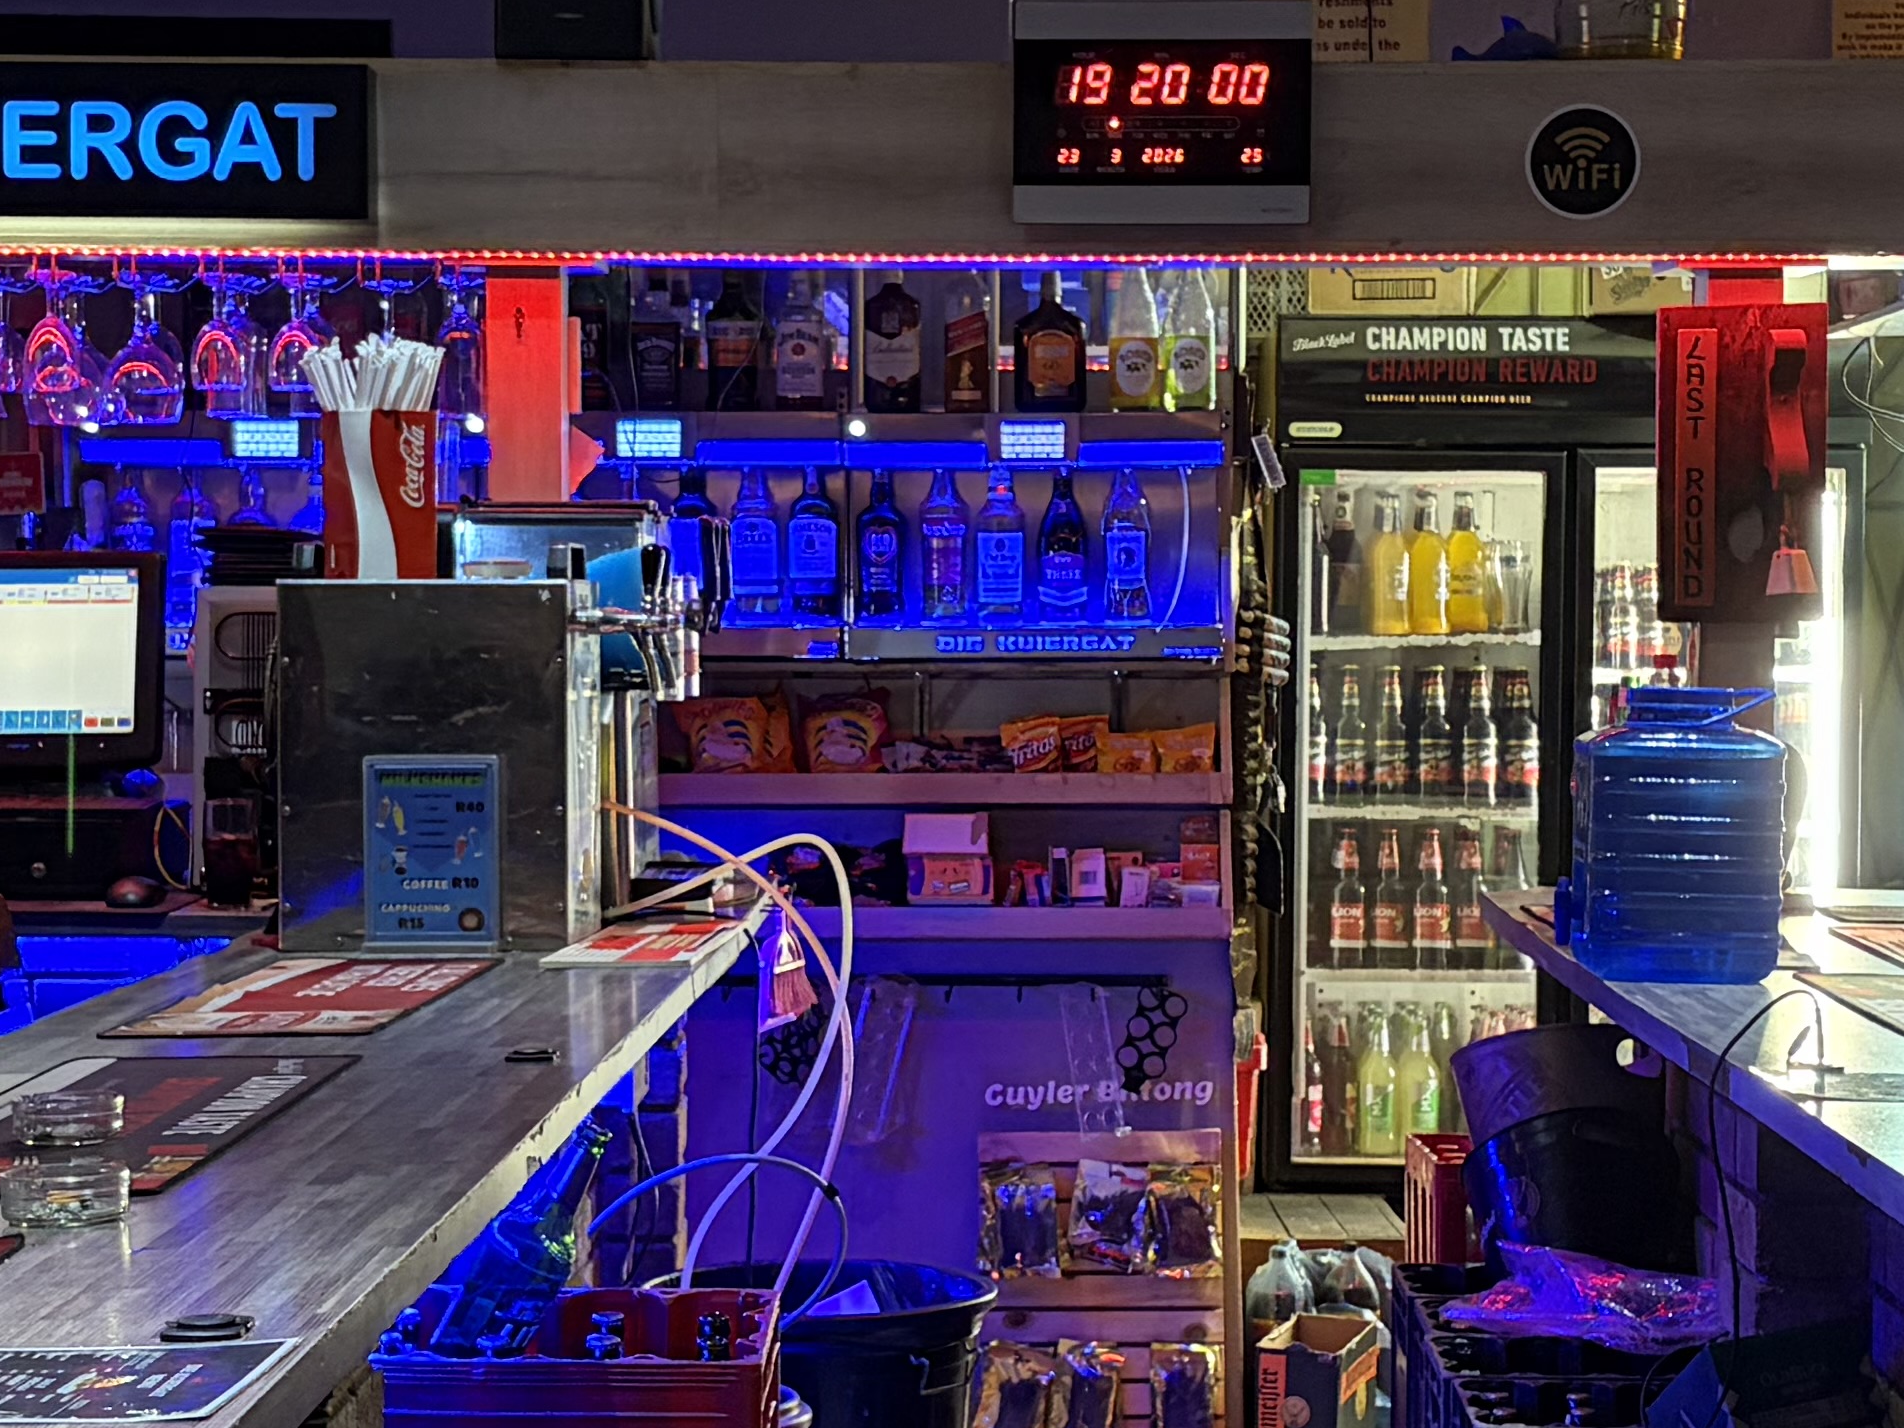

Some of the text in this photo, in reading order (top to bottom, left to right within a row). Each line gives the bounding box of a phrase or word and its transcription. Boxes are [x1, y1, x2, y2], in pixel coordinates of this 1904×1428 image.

[1318, 16, 1334, 29] be
[1339, 16, 1368, 29] sold
[1335, 40, 1401, 52] unde the
[1068, 62, 1270, 106] 19 20 00
[1056, 147, 1264, 165] 23 3 2026 25
[1542, 159, 1623, 191] WiFi
[1292, 331, 1357, 353] Black Label
[1365, 326, 1572, 353] CHAMPION TASTE
[1366, 356, 1600, 385] CHAMPION REWARD
[1684, 335, 1706, 441] LAST
[1686, 467, 1706, 599] ROUND
[996, 633, 1137, 653] KUIERGAT
[402, 876, 480, 891] COFFEE R10
[984, 1080, 1090, 1112] Cuyler
